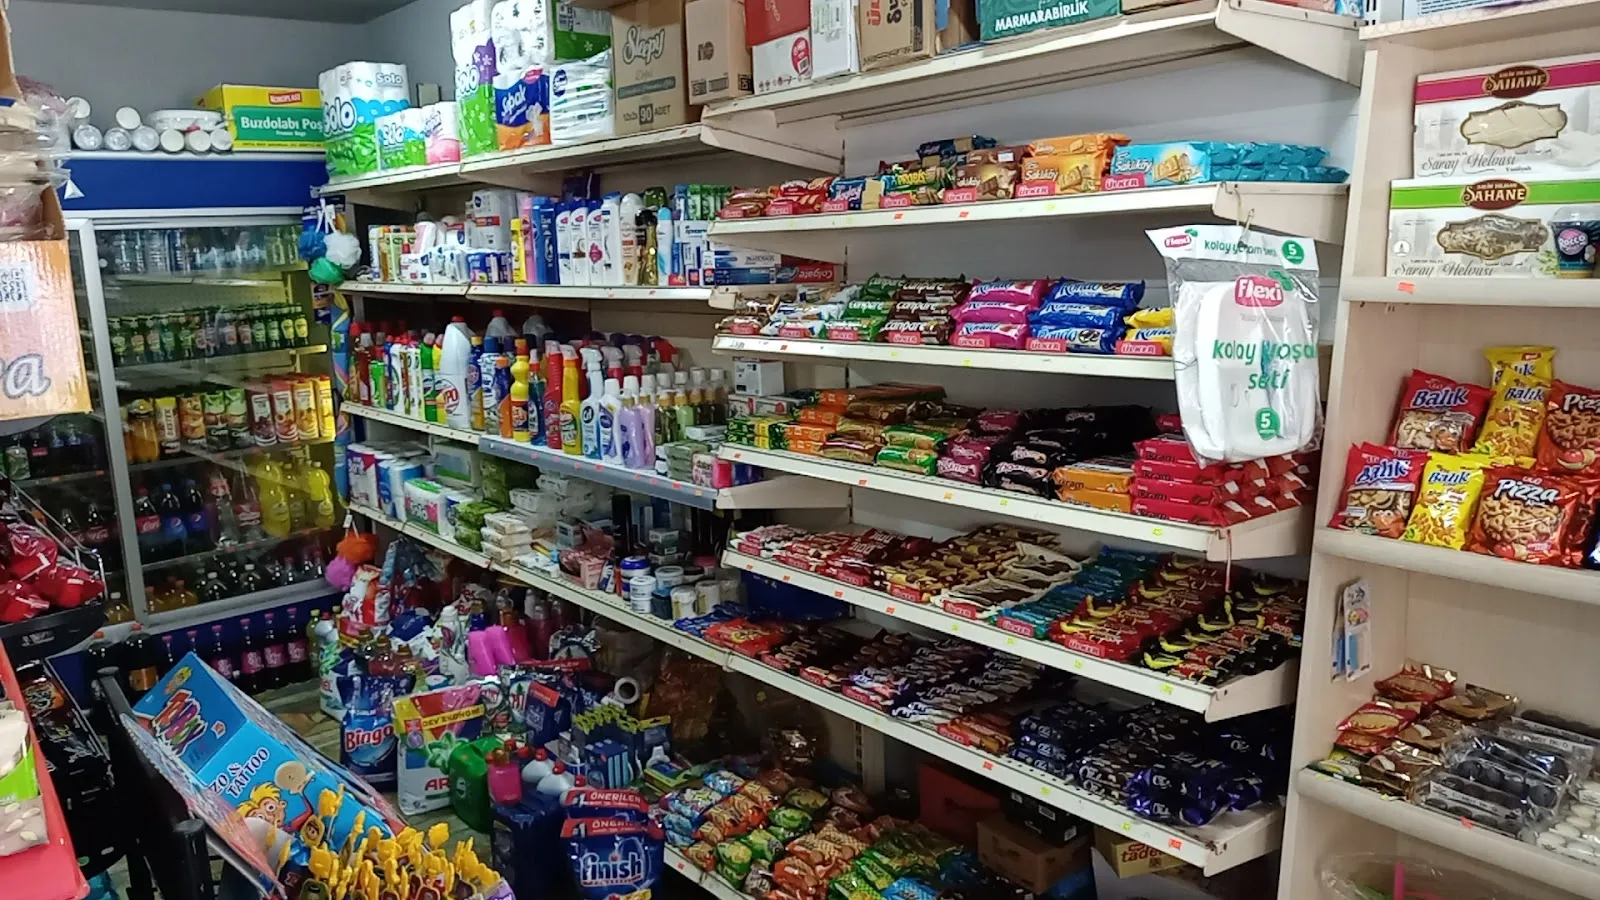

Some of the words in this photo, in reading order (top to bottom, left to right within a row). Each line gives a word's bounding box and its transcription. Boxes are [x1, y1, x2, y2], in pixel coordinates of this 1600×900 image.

[995, 1, 1089, 31] MARMARABİRLİK
[240, 115, 300, 129] Buzdolabı
[640, 107, 652, 121] 90
[1419, 157, 1459, 177] Saray
[1105, 178, 1139, 190] ÜLKER
[1165, 236, 1191, 247] Flexi
[1204, 239, 1231, 254] kolay
[1288, 244, 1297, 255] 5
[798, 268, 833, 280] Colgate
[1394, 261, 1434, 278] Saray
[1237, 281, 1283, 301] Flexi
[1122, 342, 1155, 354] ÜLKER
[1212, 339, 1256, 366] kolay
[1411, 387, 1468, 407] Balık
[1260, 413, 1271, 428] 5
[1494, 479, 1559, 502] Pizza
[344, 724, 395, 752] Bingo
[227, 748, 269, 798] TATTOO
[581, 852, 645, 882] finish
